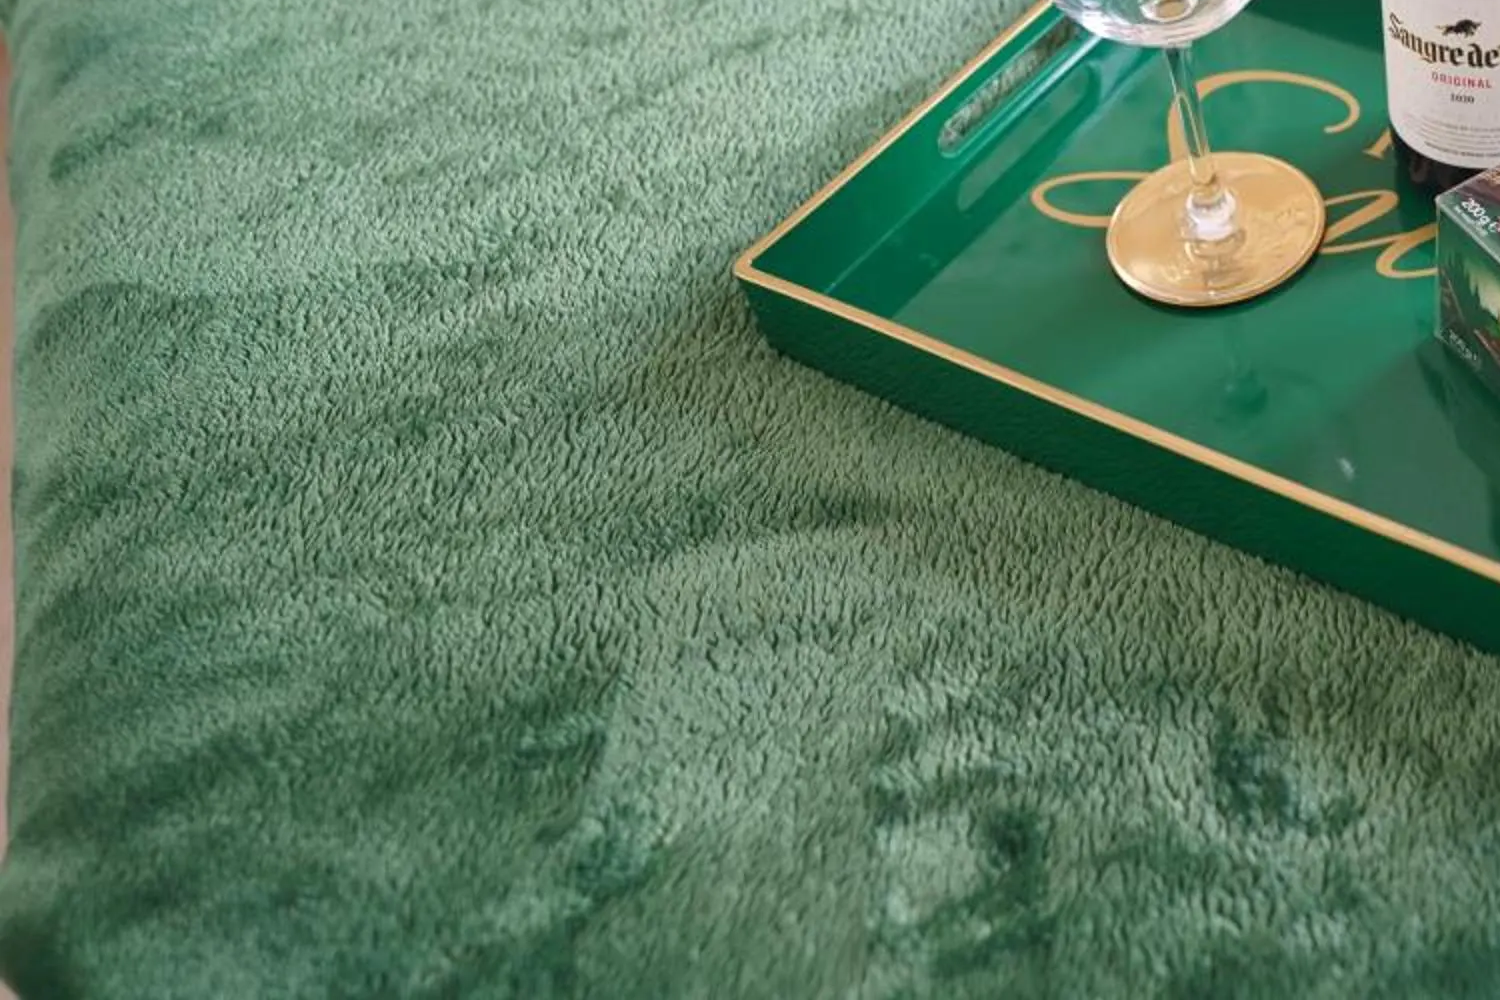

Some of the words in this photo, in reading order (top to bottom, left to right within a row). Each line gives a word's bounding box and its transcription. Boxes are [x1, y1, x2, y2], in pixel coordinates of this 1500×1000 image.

[1388, 12, 1465, 67] Sangre
[1466, 43, 1500, 70] de
[1431, 71, 1493, 89] ORIGINAL
